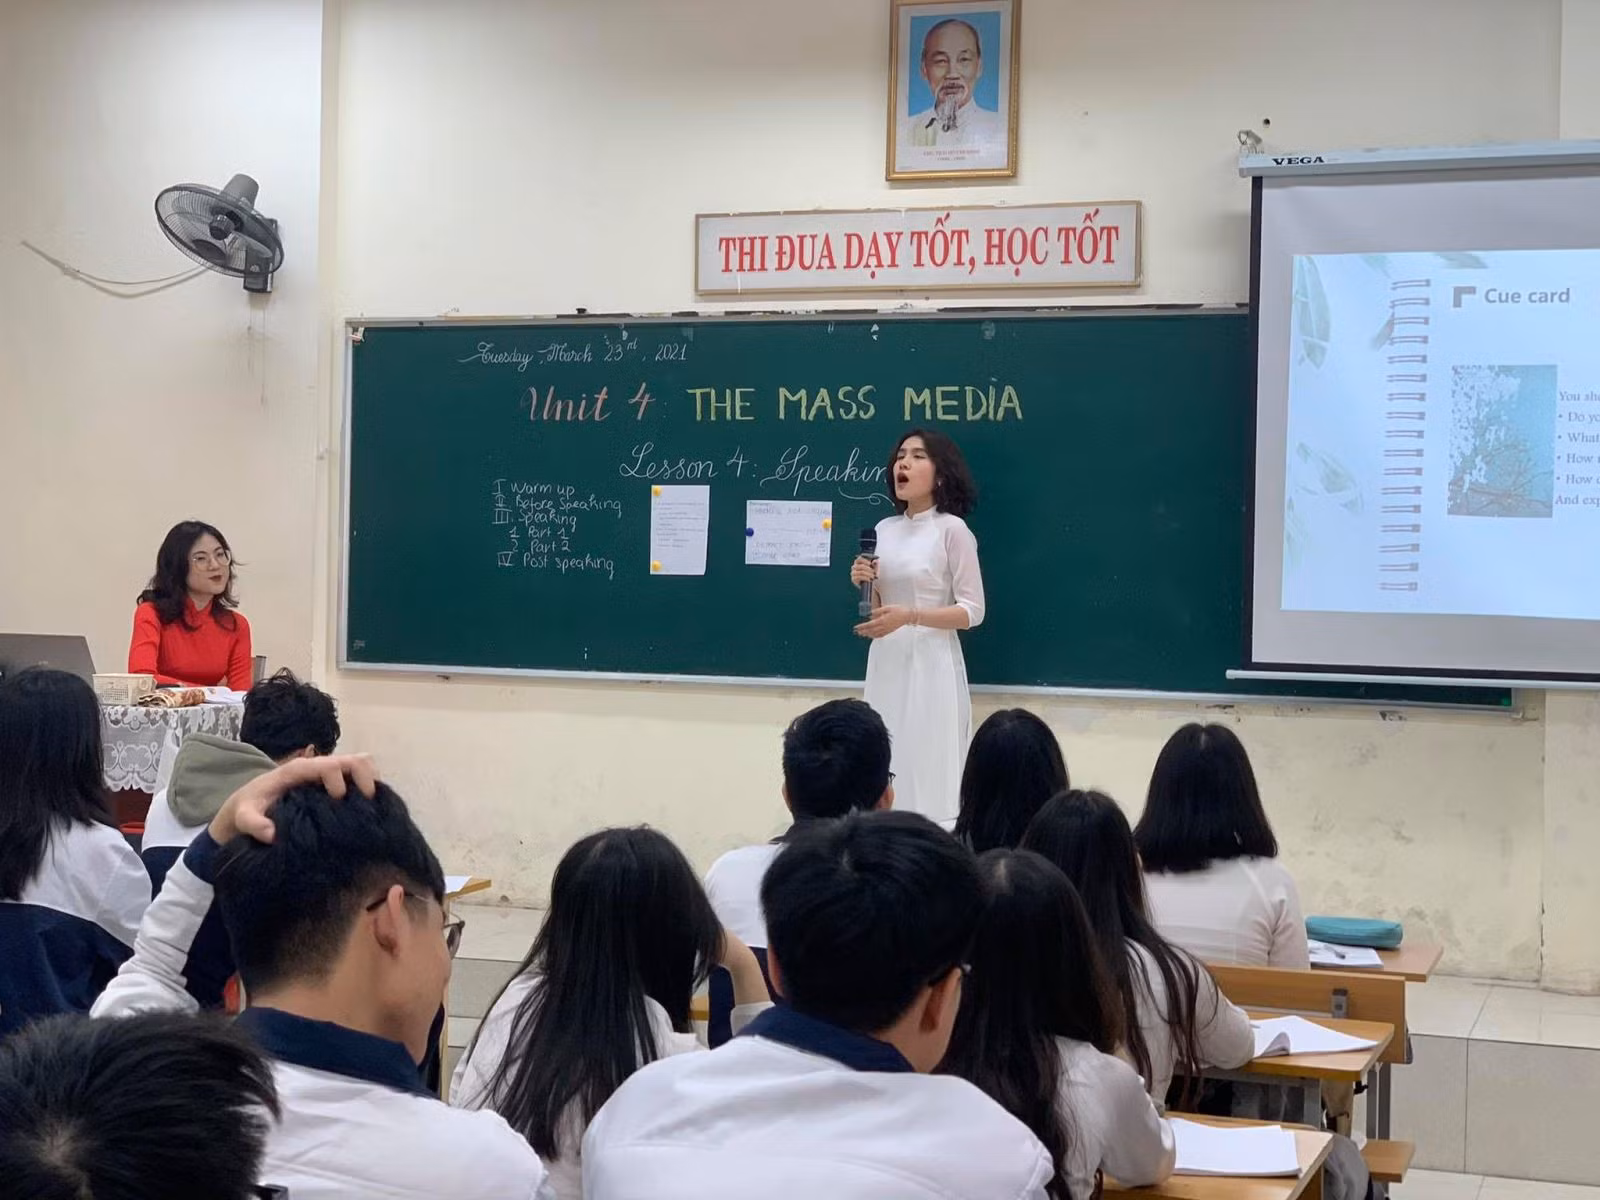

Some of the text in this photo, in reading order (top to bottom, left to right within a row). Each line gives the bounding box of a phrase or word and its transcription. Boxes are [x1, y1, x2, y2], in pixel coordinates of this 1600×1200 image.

[1271, 155, 1325, 166] VEGA
[718, 208, 1120, 280] THI ĐUA DẠY TỐT, HỌC TỐT
[1484, 286, 1571, 304] Cue card
[537, 343, 593, 363] March
[655, 343, 687, 361] 2021
[520, 384, 612, 421] Unit
[686, 386, 755, 422] THE
[778, 384, 877, 421] MASS
[1559, 391, 1581, 402] You
[1568, 411, 1585, 423] Do
[1566, 453, 1593, 464] How
[619, 441, 719, 479] Lesson
[760, 445, 894, 505] Speakin
[1566, 474, 1593, 485] How
[510, 482, 552, 495] Warm
[556, 484, 575, 500] up
[1555, 494, 1579, 505] And
[515, 494, 554, 514] Before
[518, 508, 577, 532] Speaking
[528, 525, 551, 538] Part
[530, 539, 556, 554] Part
[561, 540, 571, 552] 2
[523, 552, 548, 568] Post
[555, 552, 614, 580] speaking
